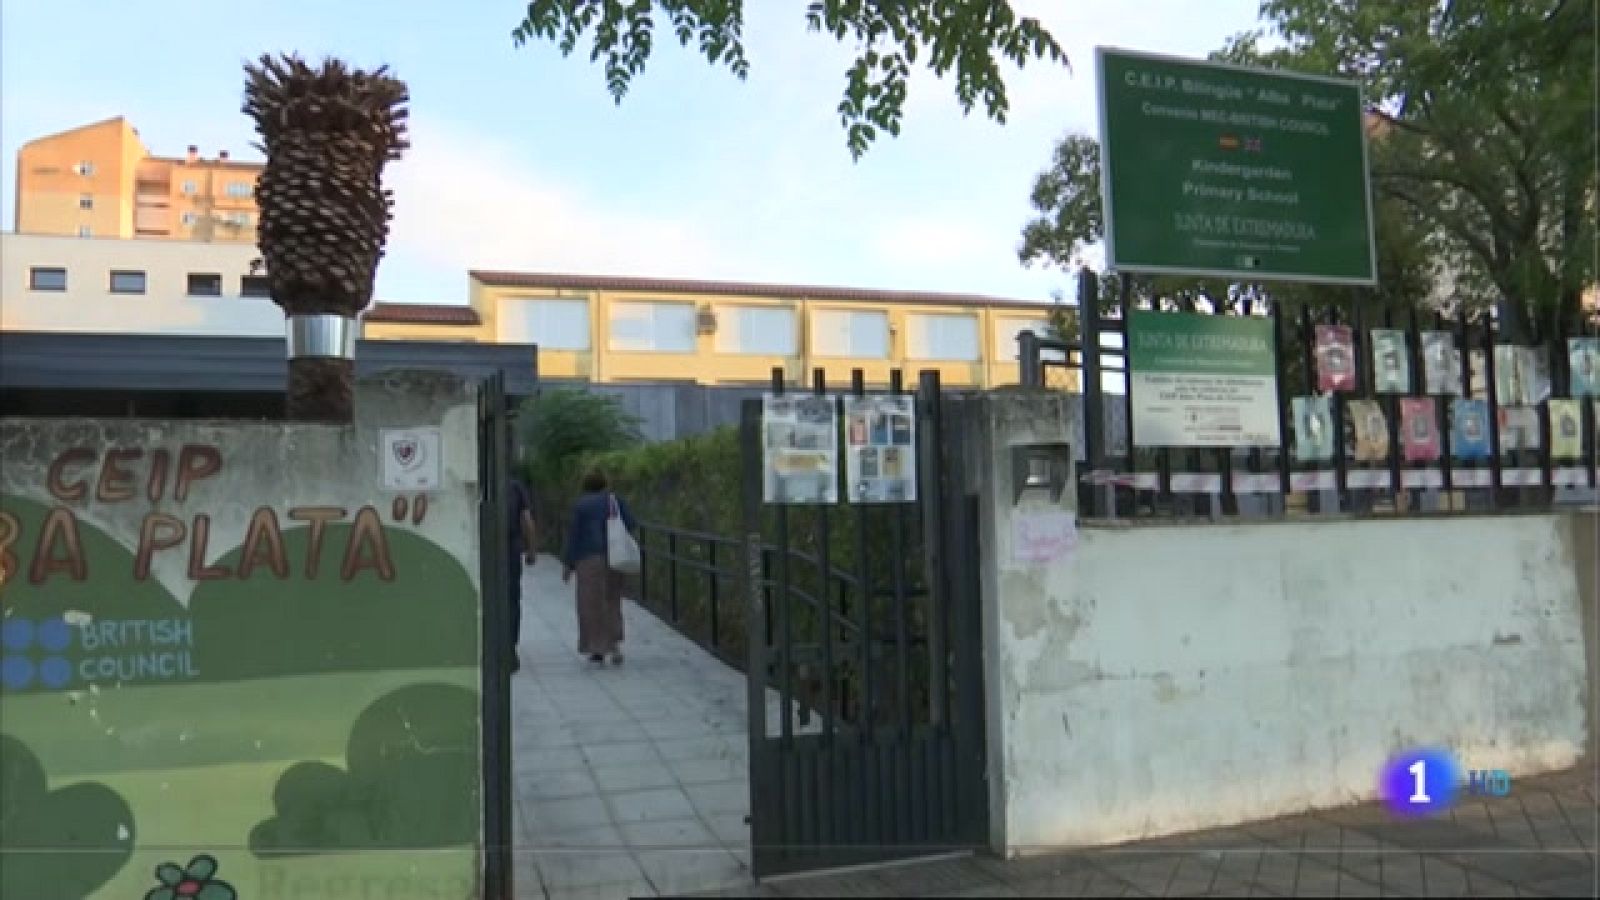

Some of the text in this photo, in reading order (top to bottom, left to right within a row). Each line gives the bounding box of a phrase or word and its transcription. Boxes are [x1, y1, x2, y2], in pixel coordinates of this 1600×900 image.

[1182, 182, 1298, 205] Primary School
[47, 445, 222, 502] CEIP
[134, 493, 429, 584] PLATA"
[79, 618, 194, 650] BRITISH
[79, 652, 201, 681] COUNCIL
